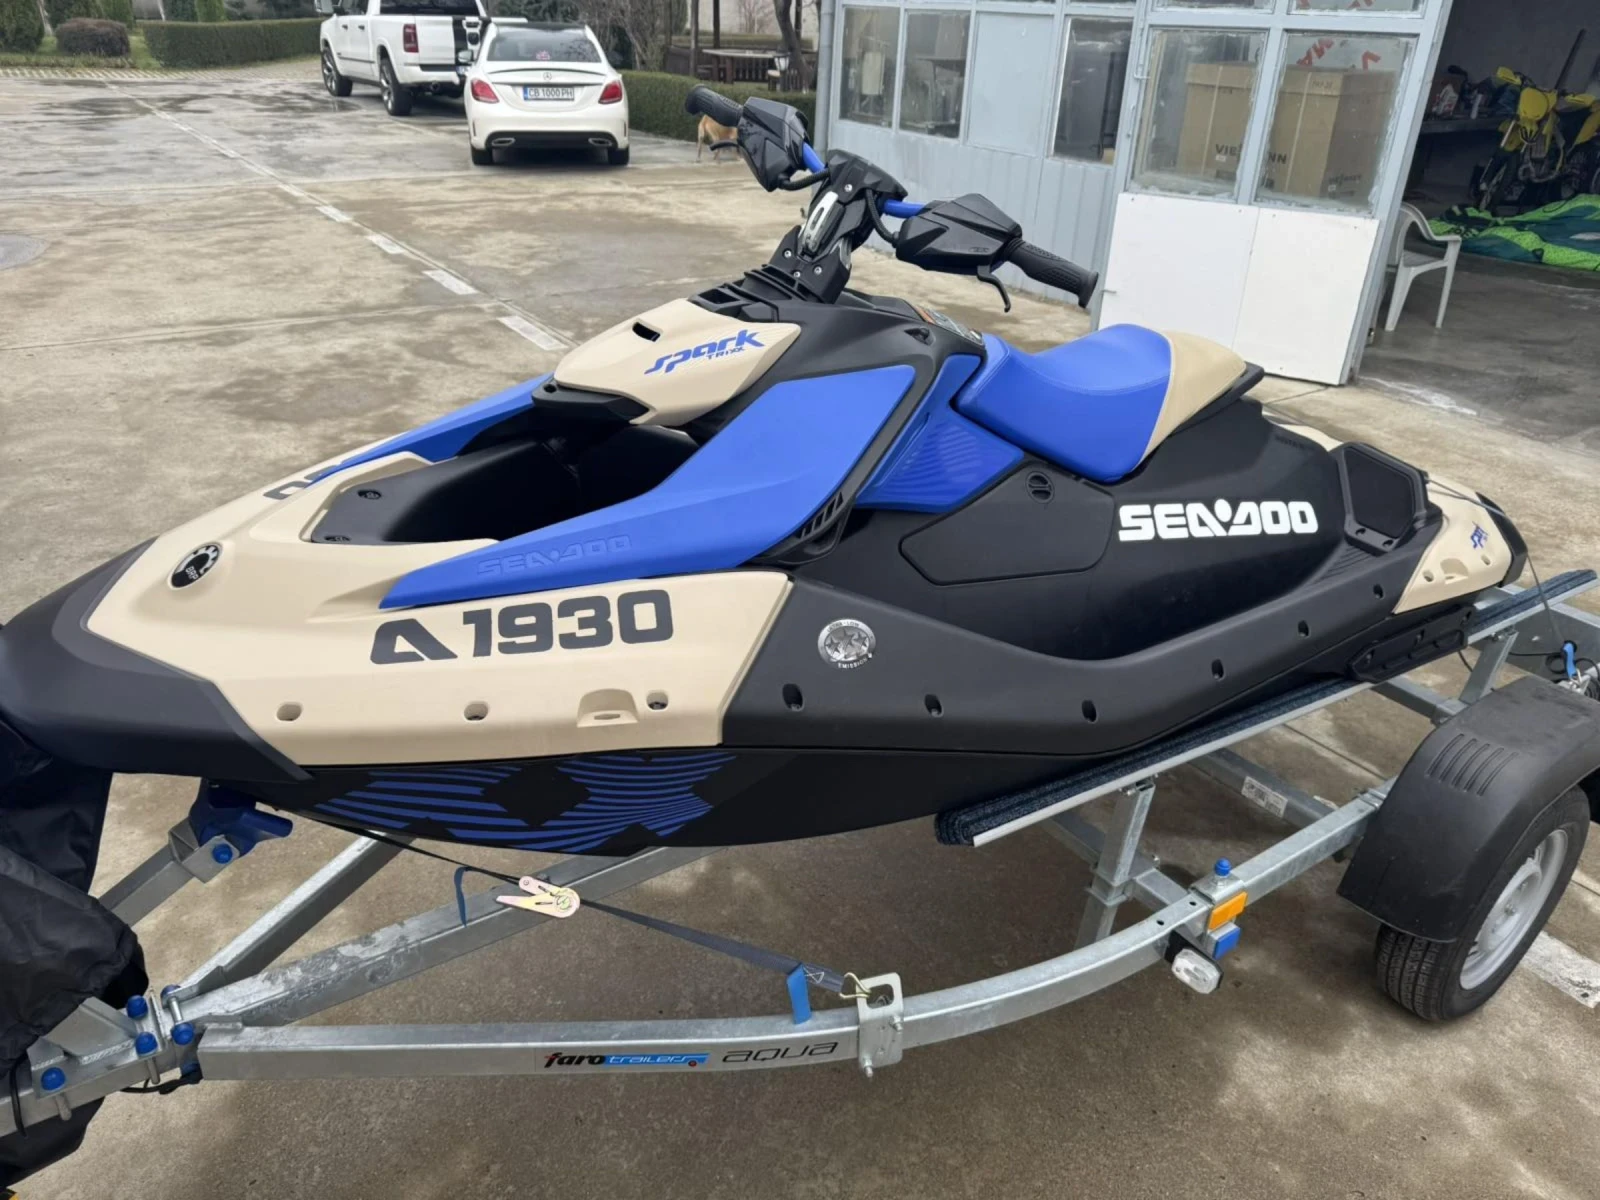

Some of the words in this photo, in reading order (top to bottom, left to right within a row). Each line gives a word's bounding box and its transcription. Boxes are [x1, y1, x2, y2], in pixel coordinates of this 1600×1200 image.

[541, 88, 560, 97] 1000
[185, 565, 199, 581] BRP
[370, 618, 458, 664] A
[462, 589, 674, 657] 1930
[544, 1052, 605, 1069] faro
